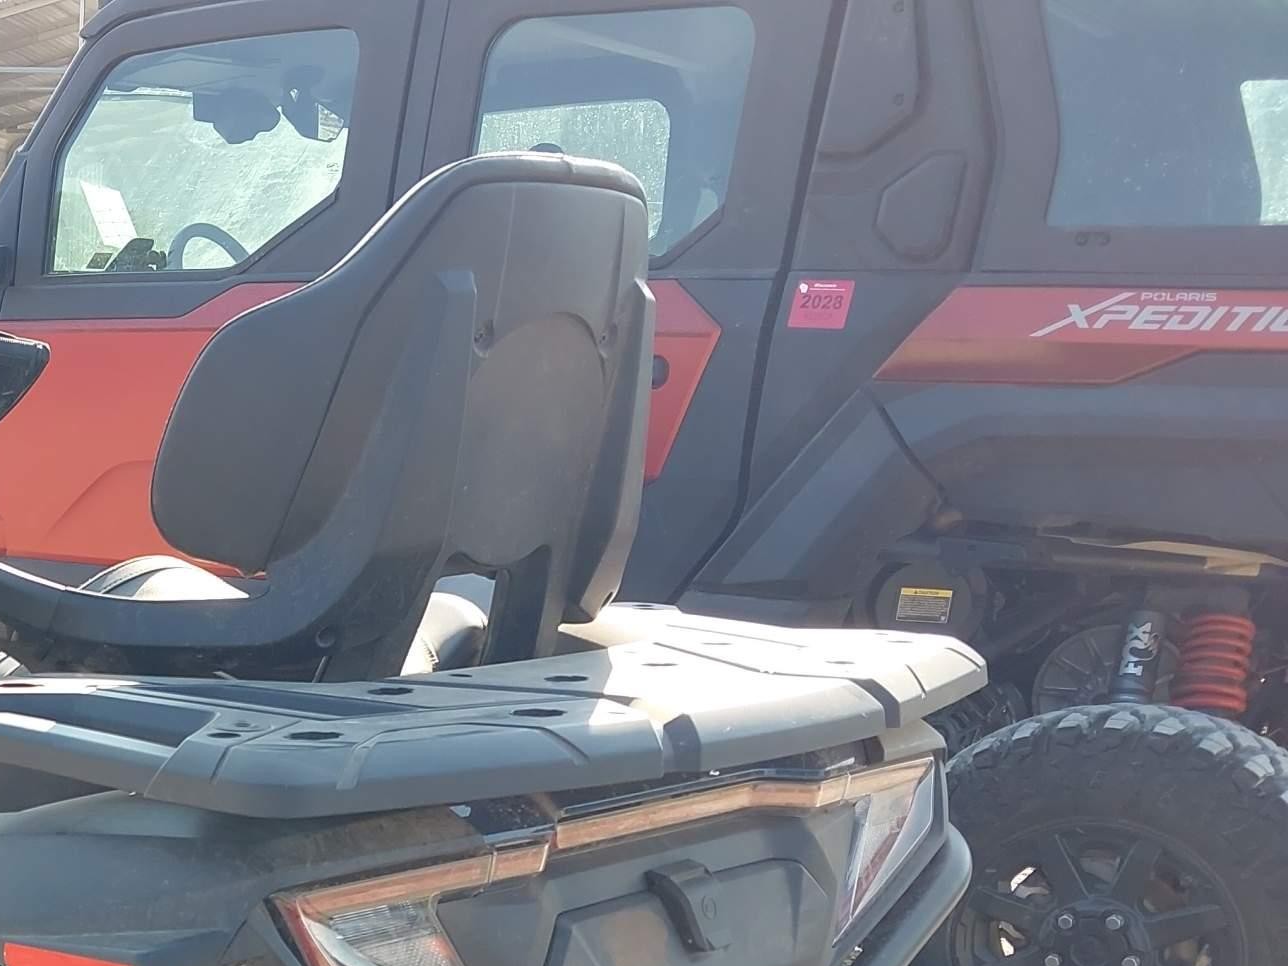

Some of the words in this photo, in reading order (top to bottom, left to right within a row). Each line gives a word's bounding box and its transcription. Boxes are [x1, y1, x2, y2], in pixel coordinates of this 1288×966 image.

[799, 294, 844, 310] 2028
[1140, 292, 1217, 302] POLARIS
[1120, 622, 1159, 676] FOX
